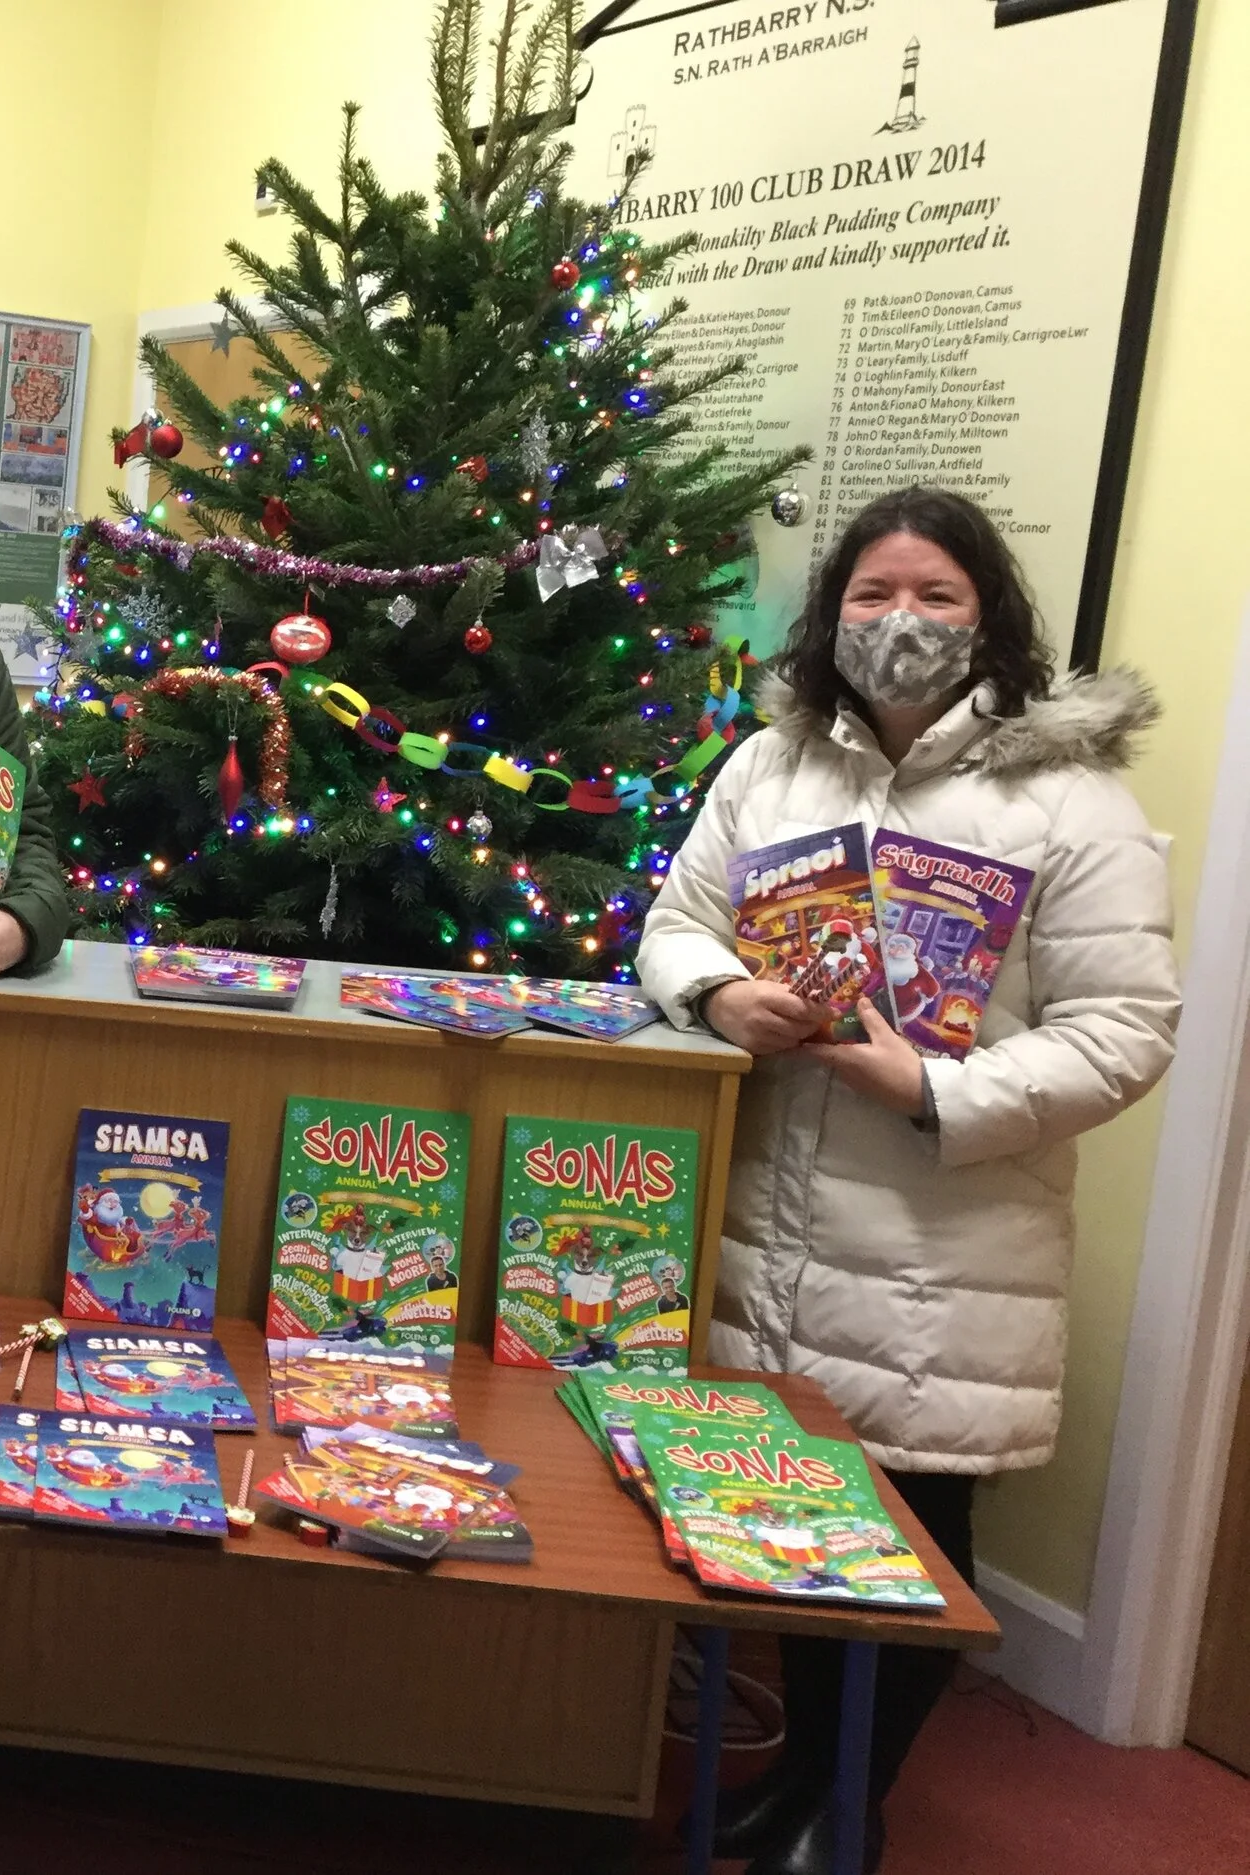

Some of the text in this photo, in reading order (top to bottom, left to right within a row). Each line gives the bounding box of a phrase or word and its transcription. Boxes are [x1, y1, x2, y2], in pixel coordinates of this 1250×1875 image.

[673, 2, 818, 56] RATHBARRY
[673, 64, 703, 85] S.N.
[707, 54, 752, 77] RATH
[709, 180, 744, 210] 100
[750, 167, 824, 204] CLUB
[830, 149, 922, 192] DRAW
[926, 138, 987, 177] 2014
[770, 215, 819, 242] Black
[823, 207, 901, 235] Pudding
[906, 195, 1001, 225] Company
[677, 262, 708, 285] with
[712, 259, 735, 281] the
[742, 254, 788, 278] Draw
[792, 247, 824, 271] and
[829, 239, 886, 270] kindly
[889, 226, 986, 265] supported
[992, 224, 1011, 248] it.
[844, 298, 856, 310] 69
[863, 297, 879, 308] Pat
[976, 285, 1013, 297] Camus
[843, 313, 855, 324] 70
[862, 311, 880, 322] Tim
[890, 308, 921, 320] Eileen
[985, 300, 1022, 312] Camus
[838, 343, 850, 354] 72
[894, 339, 920, 352] Mary
[1012, 328, 1067, 343] Carrigroe
[1067, 326, 1090, 338] Lwr
[841, 328, 851, 339] 71
[837, 357, 848, 368] 73
[931, 349, 969, 363] Lisduff
[835, 372, 846, 383] 74
[940, 366, 977, 378] Kilkern
[833, 387, 844, 398] 75
[941, 381, 981, 393] Donour
[982, 379, 1006, 391] East
[831, 402, 842, 413] 76
[849, 401, 879, 412] Anton
[890, 399, 918, 411] Fiona
[976, 394, 1015, 407] Kilkern
[829, 416, 841, 427] 77
[847, 416, 876, 427] Annie
[930, 413, 958, 426] Mary
[827, 431, 838, 442] 78
[845, 430, 869, 442] John
[959, 427, 1008, 439] Milltown
[825, 445, 837, 457] 79
[931, 443, 982, 454] Dunowen
[822, 460, 835, 471] 80
[841, 459, 882, 471] Caroline
[939, 457, 983, 470] Ardfield
[821, 475, 832, 486] 81
[974, 473, 1011, 488] Family
[819, 489, 831, 500] 82
[817, 504, 829, 515] 83
[815, 518, 827, 529] 84
[813, 532, 825, 543] 85
[811, 546, 823, 557] 86
[743, 836, 847, 900] Spraoi
[874, 843, 1016, 906] Súgradh
[301, 1113, 450, 1188] SONAS
[131, 1153, 174, 1168] ANNUAL
[524, 1134, 676, 1209] SONAS
[335, 1176, 379, 1190] ANNUAL
[560, 1198, 605, 1211] ANNUAL
[278, 1228, 332, 1246] INTERVIEW
[385, 1226, 437, 1247] INTERVIEW
[395, 1240, 421, 1255] with
[279, 1252, 328, 1271] MAGUIRE
[502, 1252, 559, 1269] INTERVIEW
[613, 1248, 667, 1270] INTERVIEW
[386, 1262, 428, 1288] MOORE
[623, 1262, 650, 1277] with
[295, 1268, 331, 1295] TOP 10
[506, 1277, 556, 1295] MAGUIRE
[522, 1292, 559, 1320] TOP 10
[616, 1285, 658, 1310] MOORE
[401, 1332, 428, 1342] FOLENS
[603, 1382, 768, 1418] SONAS
[664, 1442, 846, 1492] SONAS
